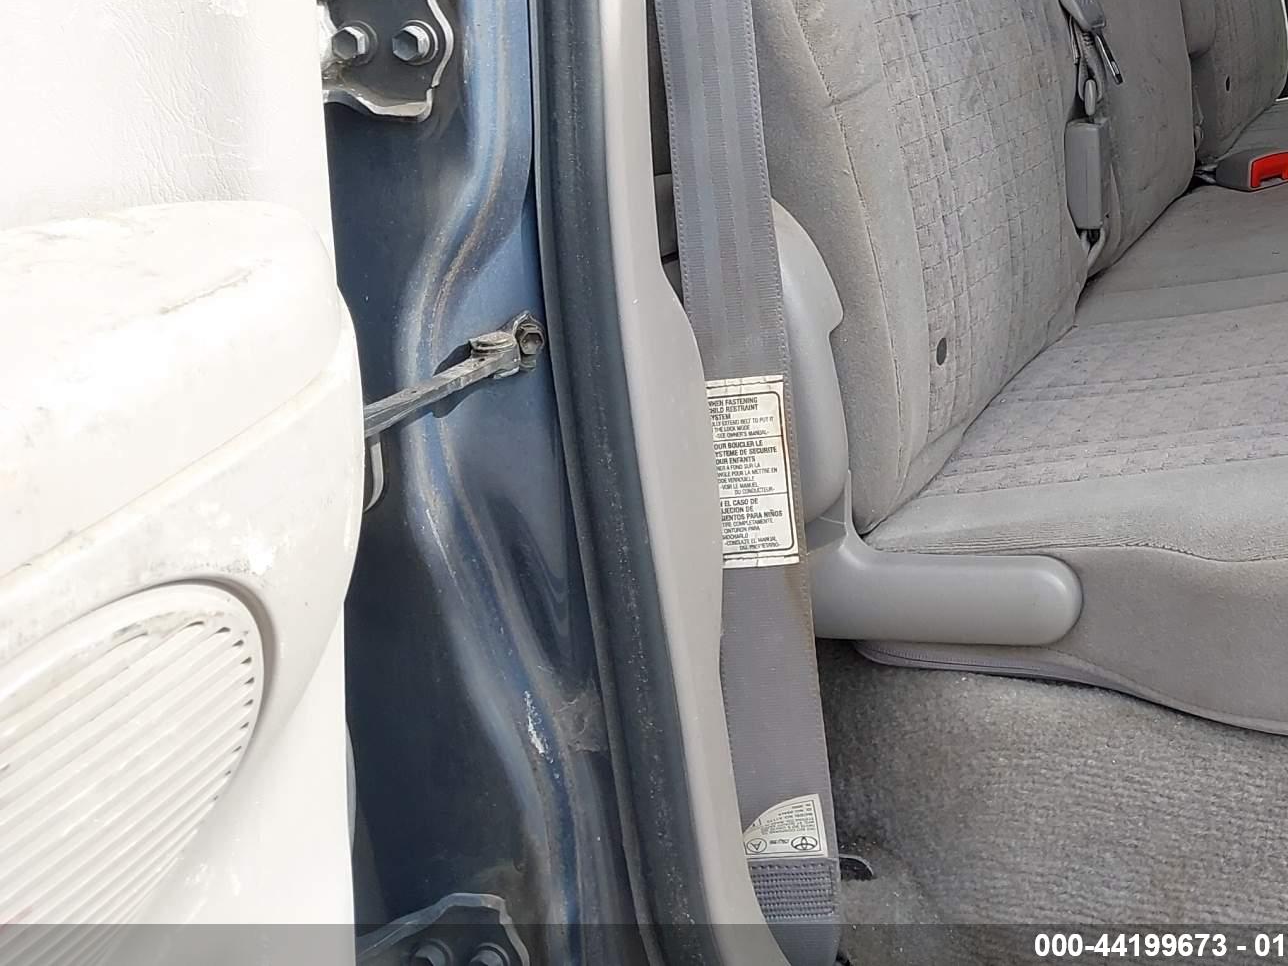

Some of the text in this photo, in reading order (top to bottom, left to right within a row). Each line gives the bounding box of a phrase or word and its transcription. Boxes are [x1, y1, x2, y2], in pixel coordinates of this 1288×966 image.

[725, 397, 758, 405] FASTENING
[725, 404, 759, 413] RESTRAINT
[728, 441, 754, 449] BOUCLER
[729, 456, 756, 464] ENFANTS
[746, 512, 763, 520] PARA
[764, 509, 783, 518] NIÑOS
